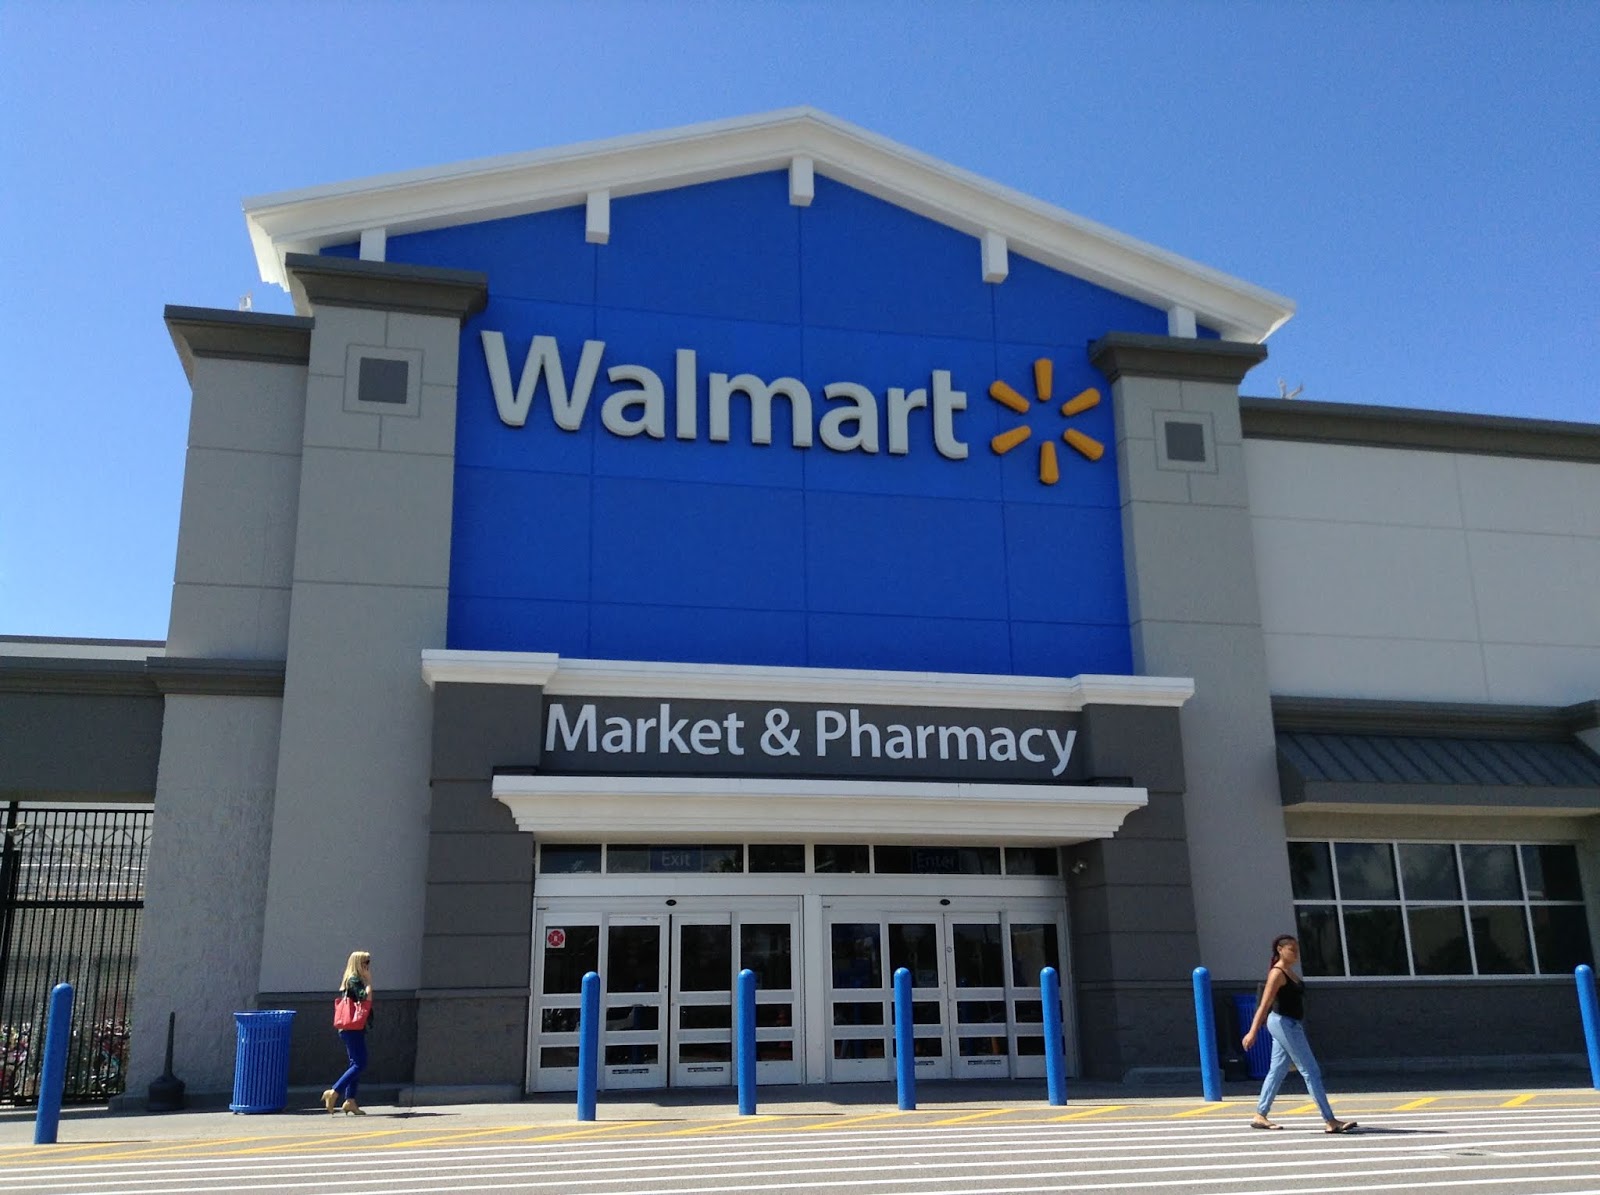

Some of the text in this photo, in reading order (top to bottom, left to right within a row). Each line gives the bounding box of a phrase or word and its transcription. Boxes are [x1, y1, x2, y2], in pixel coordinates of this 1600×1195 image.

[481, 330, 969, 460] Walmart
[545, 703, 1077, 776] Market & Pharmacy
[661, 850, 690, 867] Exit
[916, 851, 955, 869] Enter
